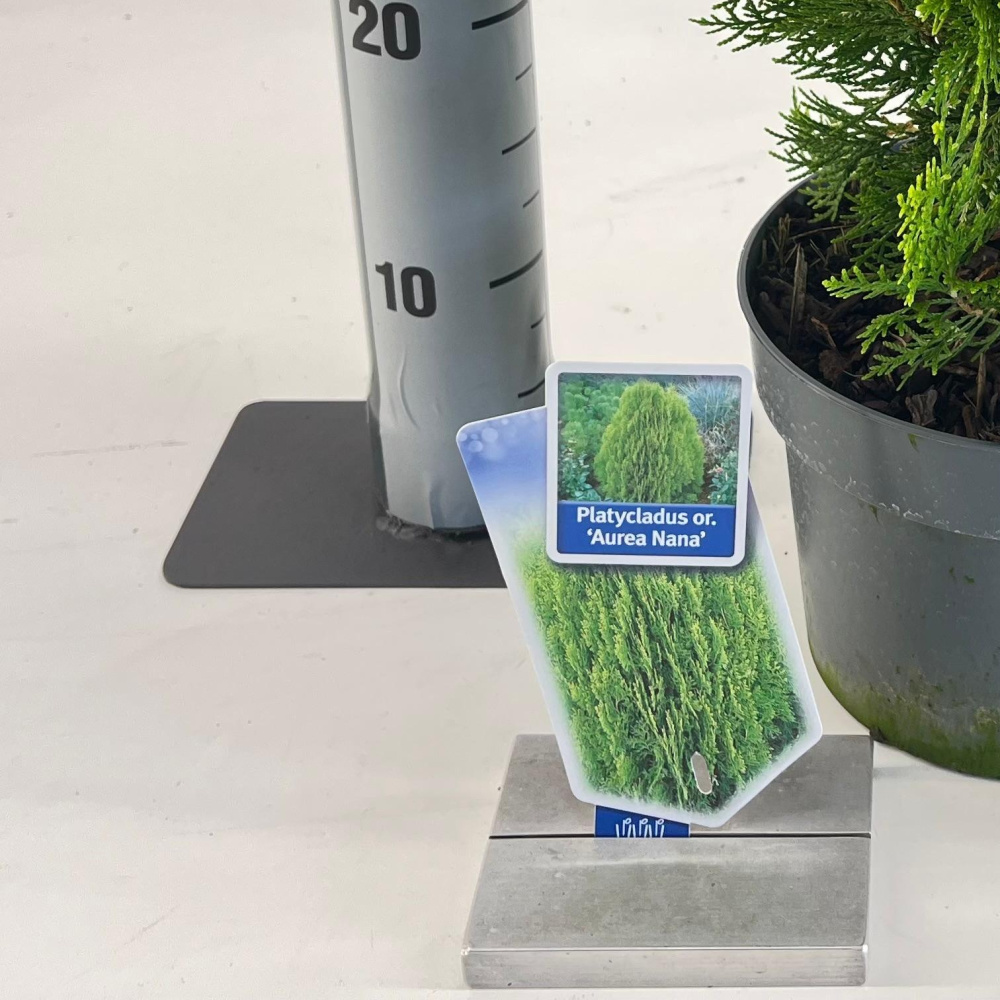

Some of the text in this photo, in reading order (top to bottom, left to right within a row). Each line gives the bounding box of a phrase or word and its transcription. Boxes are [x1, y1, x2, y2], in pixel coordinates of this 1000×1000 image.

[375, 261, 437, 318] 10
[576, 506, 717, 528] Platycladus or.
